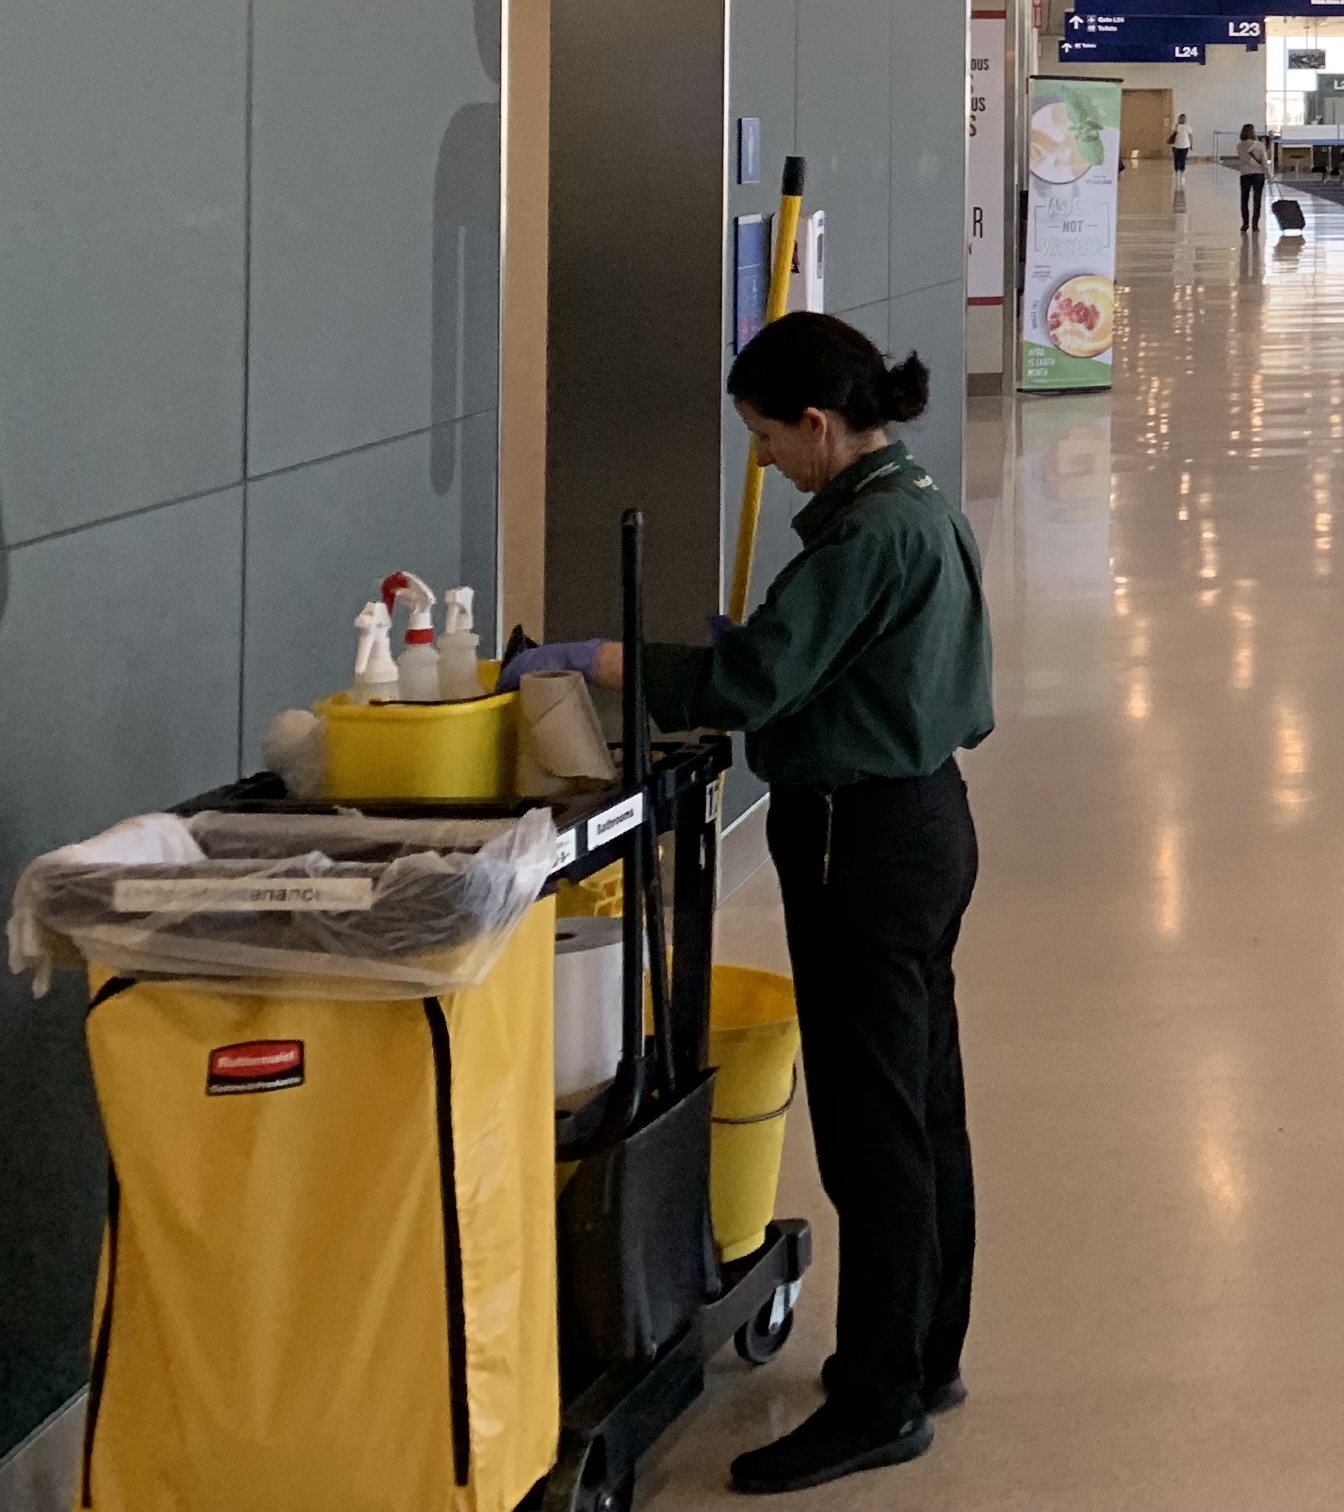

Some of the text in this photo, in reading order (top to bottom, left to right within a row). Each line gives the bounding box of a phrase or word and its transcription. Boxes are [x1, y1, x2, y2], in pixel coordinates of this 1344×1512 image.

[1228, 21, 1261, 37] L23
[1174, 46, 1199, 58] L24
[1062, 220, 1084, 233] NOT
